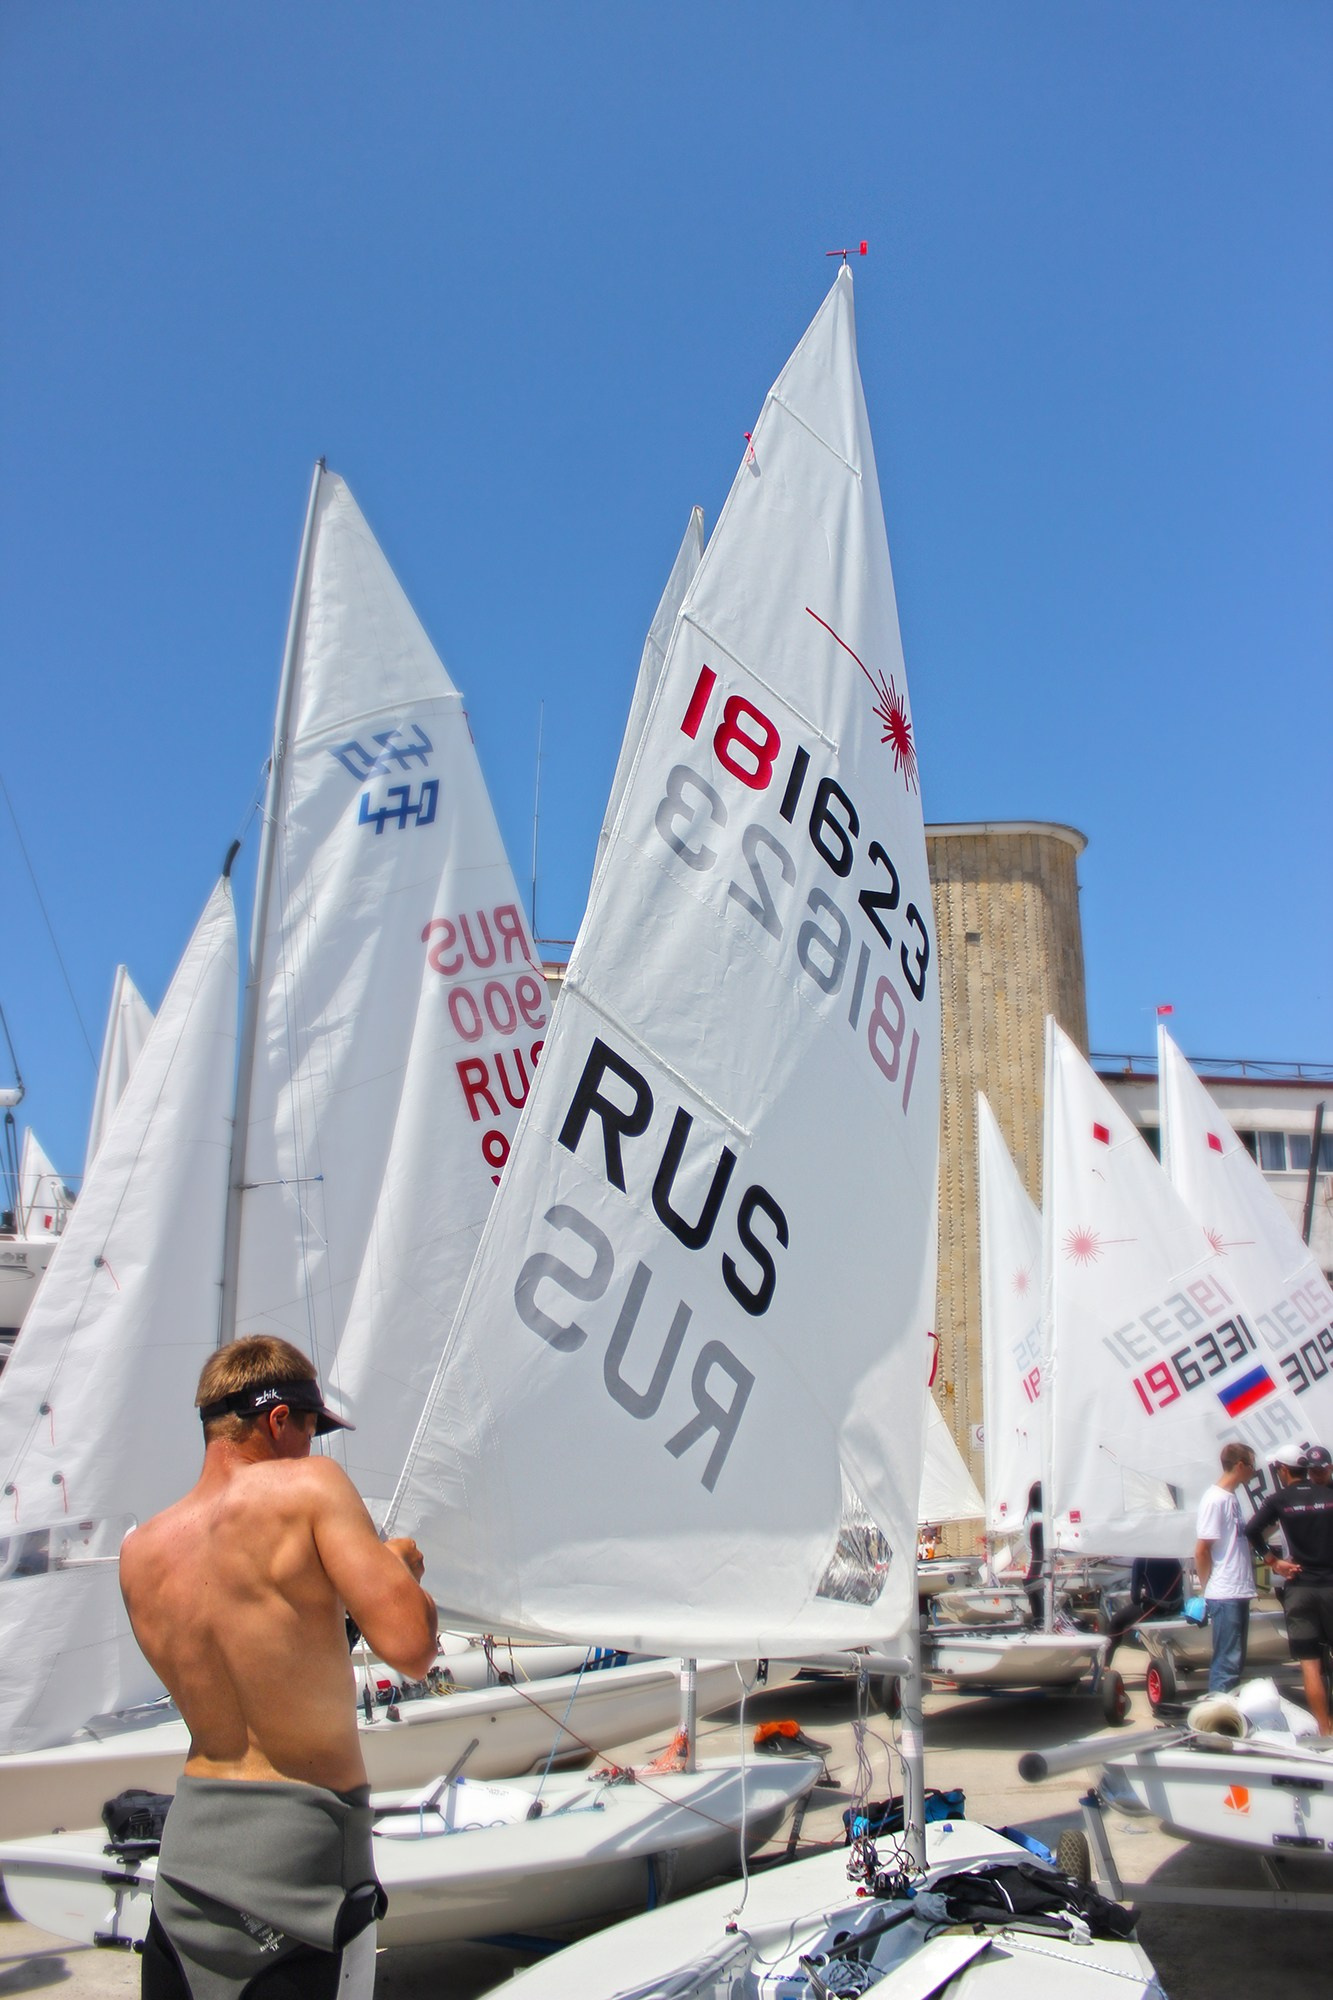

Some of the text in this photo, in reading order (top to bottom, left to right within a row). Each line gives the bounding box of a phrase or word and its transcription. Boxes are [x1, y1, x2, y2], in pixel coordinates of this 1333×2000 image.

[680, 664, 930, 1002] 181623
[557, 1036, 789, 1317] RUS
[1133, 1314, 1257, 1416] 196331
[1279, 1321, 1333, 1396] 309
